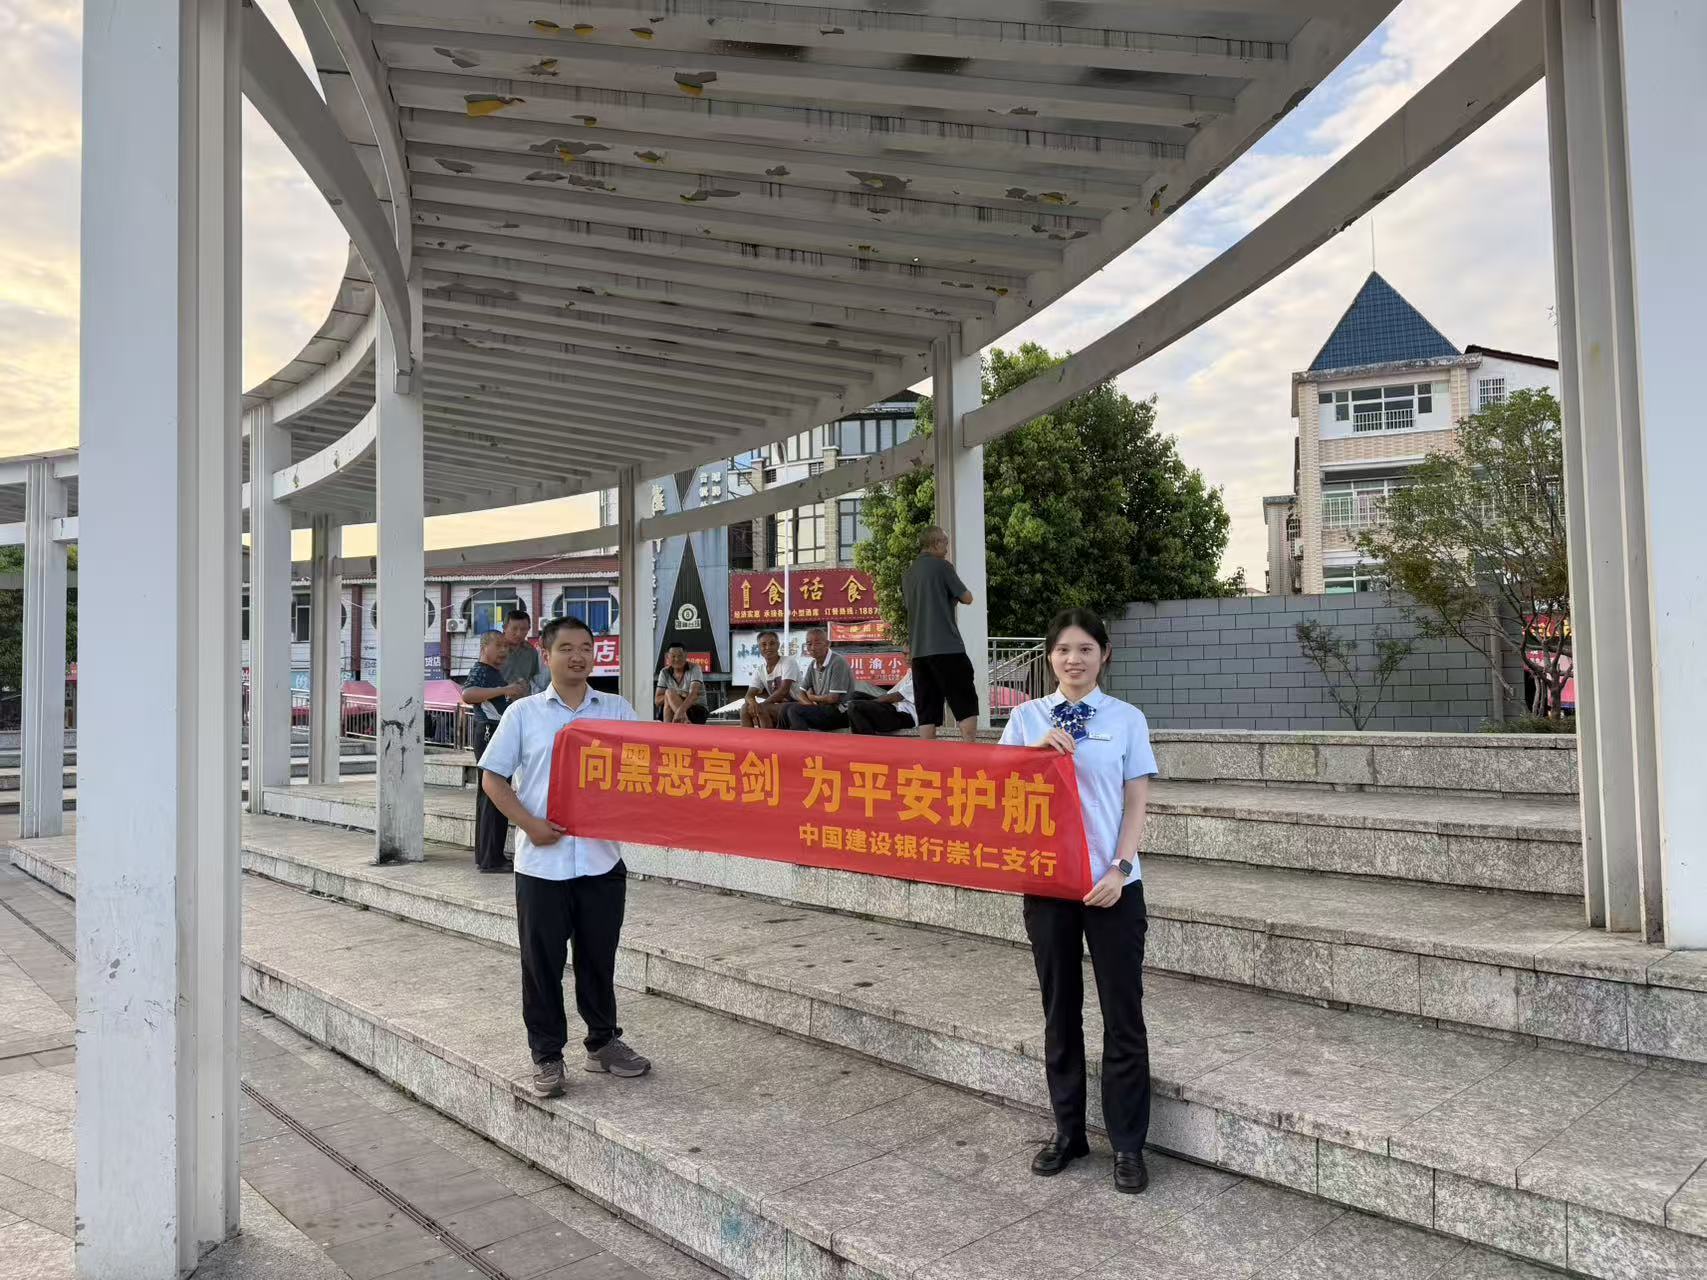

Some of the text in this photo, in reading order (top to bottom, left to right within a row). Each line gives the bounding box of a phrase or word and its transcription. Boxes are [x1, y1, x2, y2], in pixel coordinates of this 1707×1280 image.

[578, 738, 1056, 837] 向黑恶亮剑 为平安护航
[799, 822, 1057, 877] 中国建设银行崇仁支行
